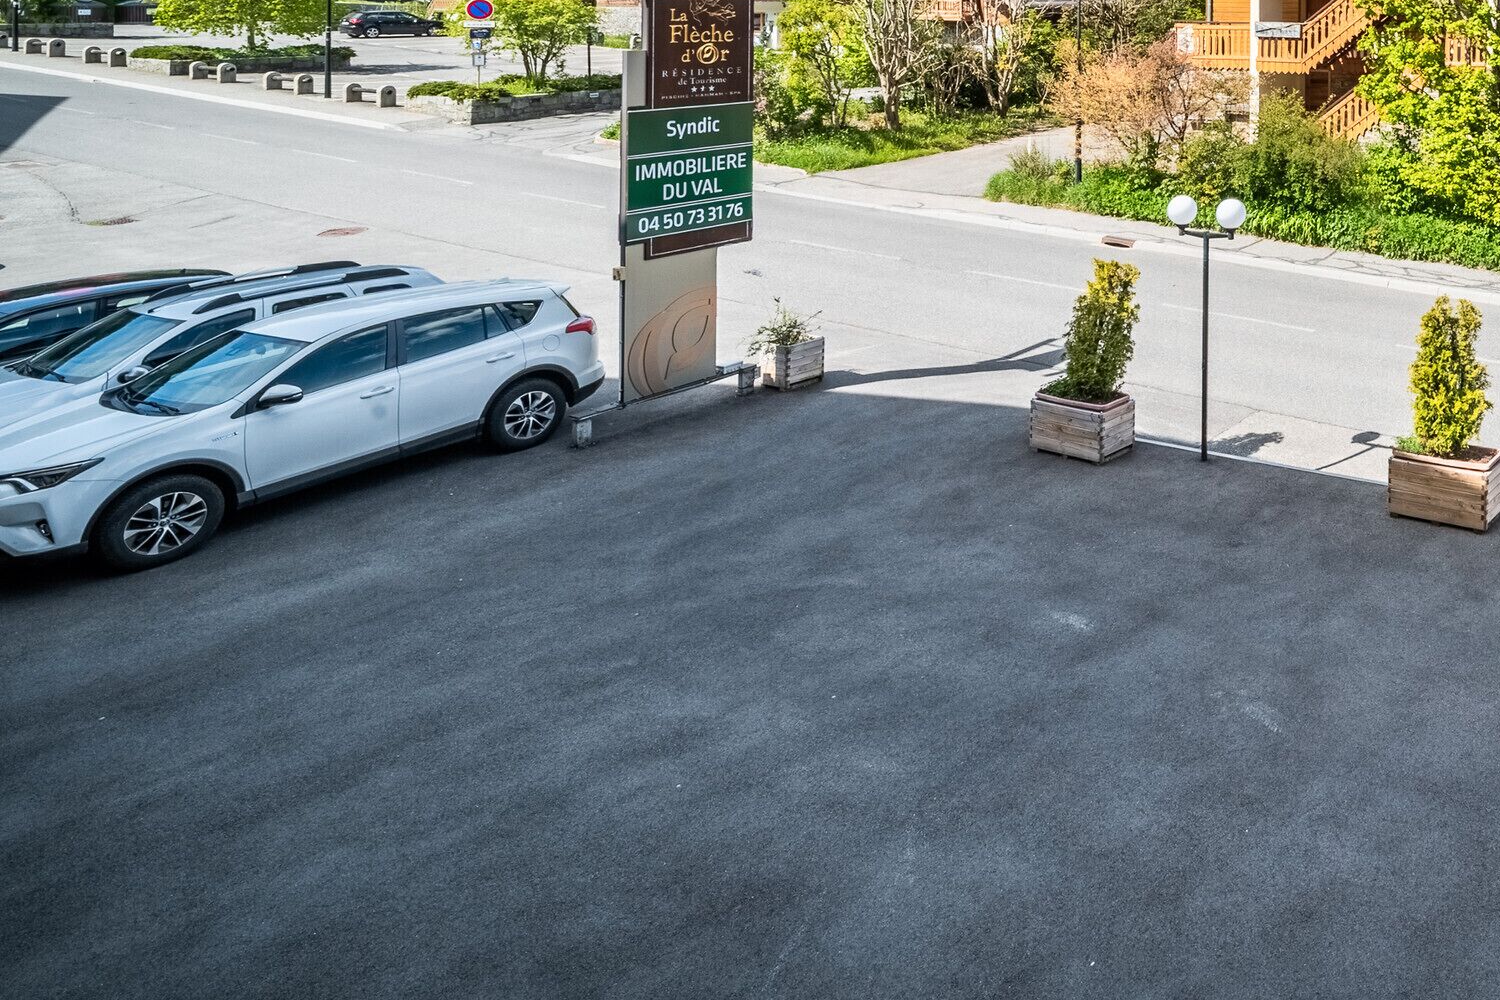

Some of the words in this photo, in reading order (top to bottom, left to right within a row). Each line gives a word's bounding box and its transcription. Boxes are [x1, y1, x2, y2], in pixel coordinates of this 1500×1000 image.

[670, 8, 688, 22] La
[669, 23, 734, 44] Flèche
[681, 42, 730, 65] d'Or
[661, 66, 743, 78] RÉSIDENCE
[678, 78, 688, 86] de
[690, 76, 727, 85] Tourisme
[666, 116, 720, 140] Syndic
[635, 152, 747, 182] IMMOBILIERE
[662, 182, 687, 201] DU
[691, 177, 723, 196] VAL
[638, 216, 660, 234] 04
[663, 212, 684, 230] 50
[687, 208, 705, 225] 73
[707, 205, 723, 222] 31
[725, 202, 744, 219] 76
